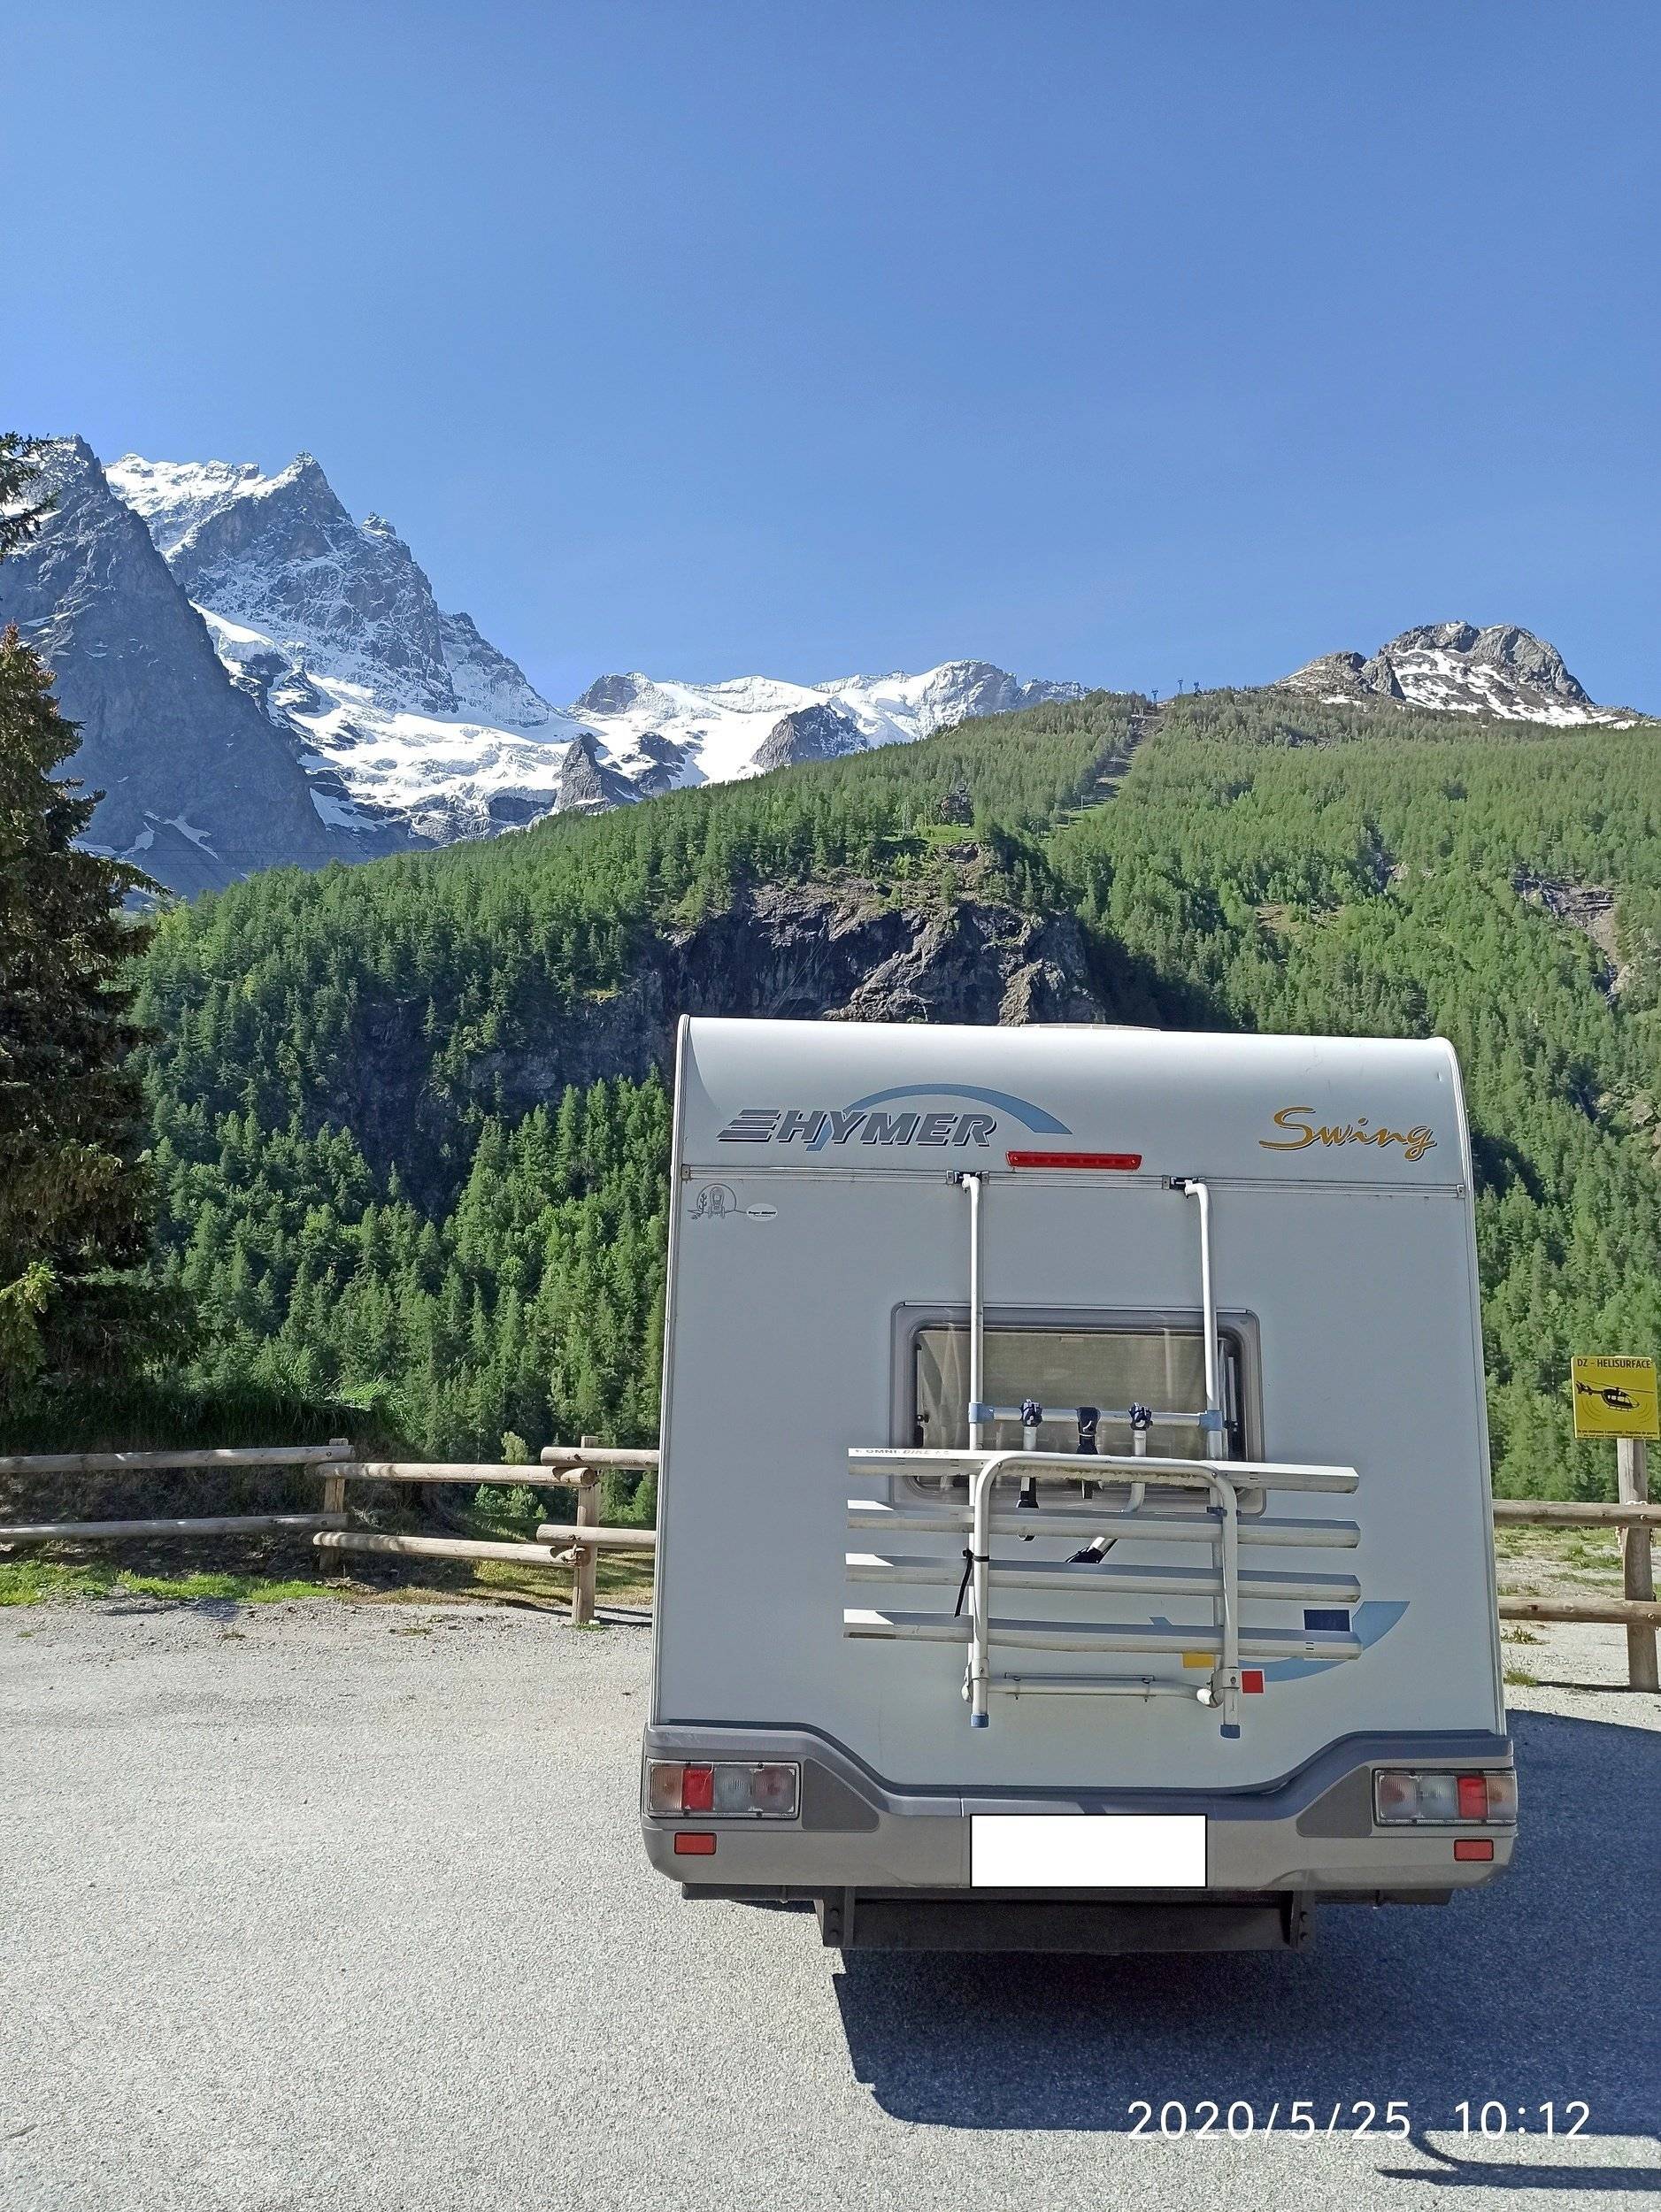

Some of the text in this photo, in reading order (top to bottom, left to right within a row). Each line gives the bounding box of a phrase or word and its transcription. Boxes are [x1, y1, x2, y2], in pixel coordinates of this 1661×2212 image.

[774, 1109, 997, 1148] HYMER
[1258, 1106, 1437, 1162] Swing
[1577, 1358, 1588, 1367] DZ
[1596, 1359, 1651, 1369] HELISURFACE
